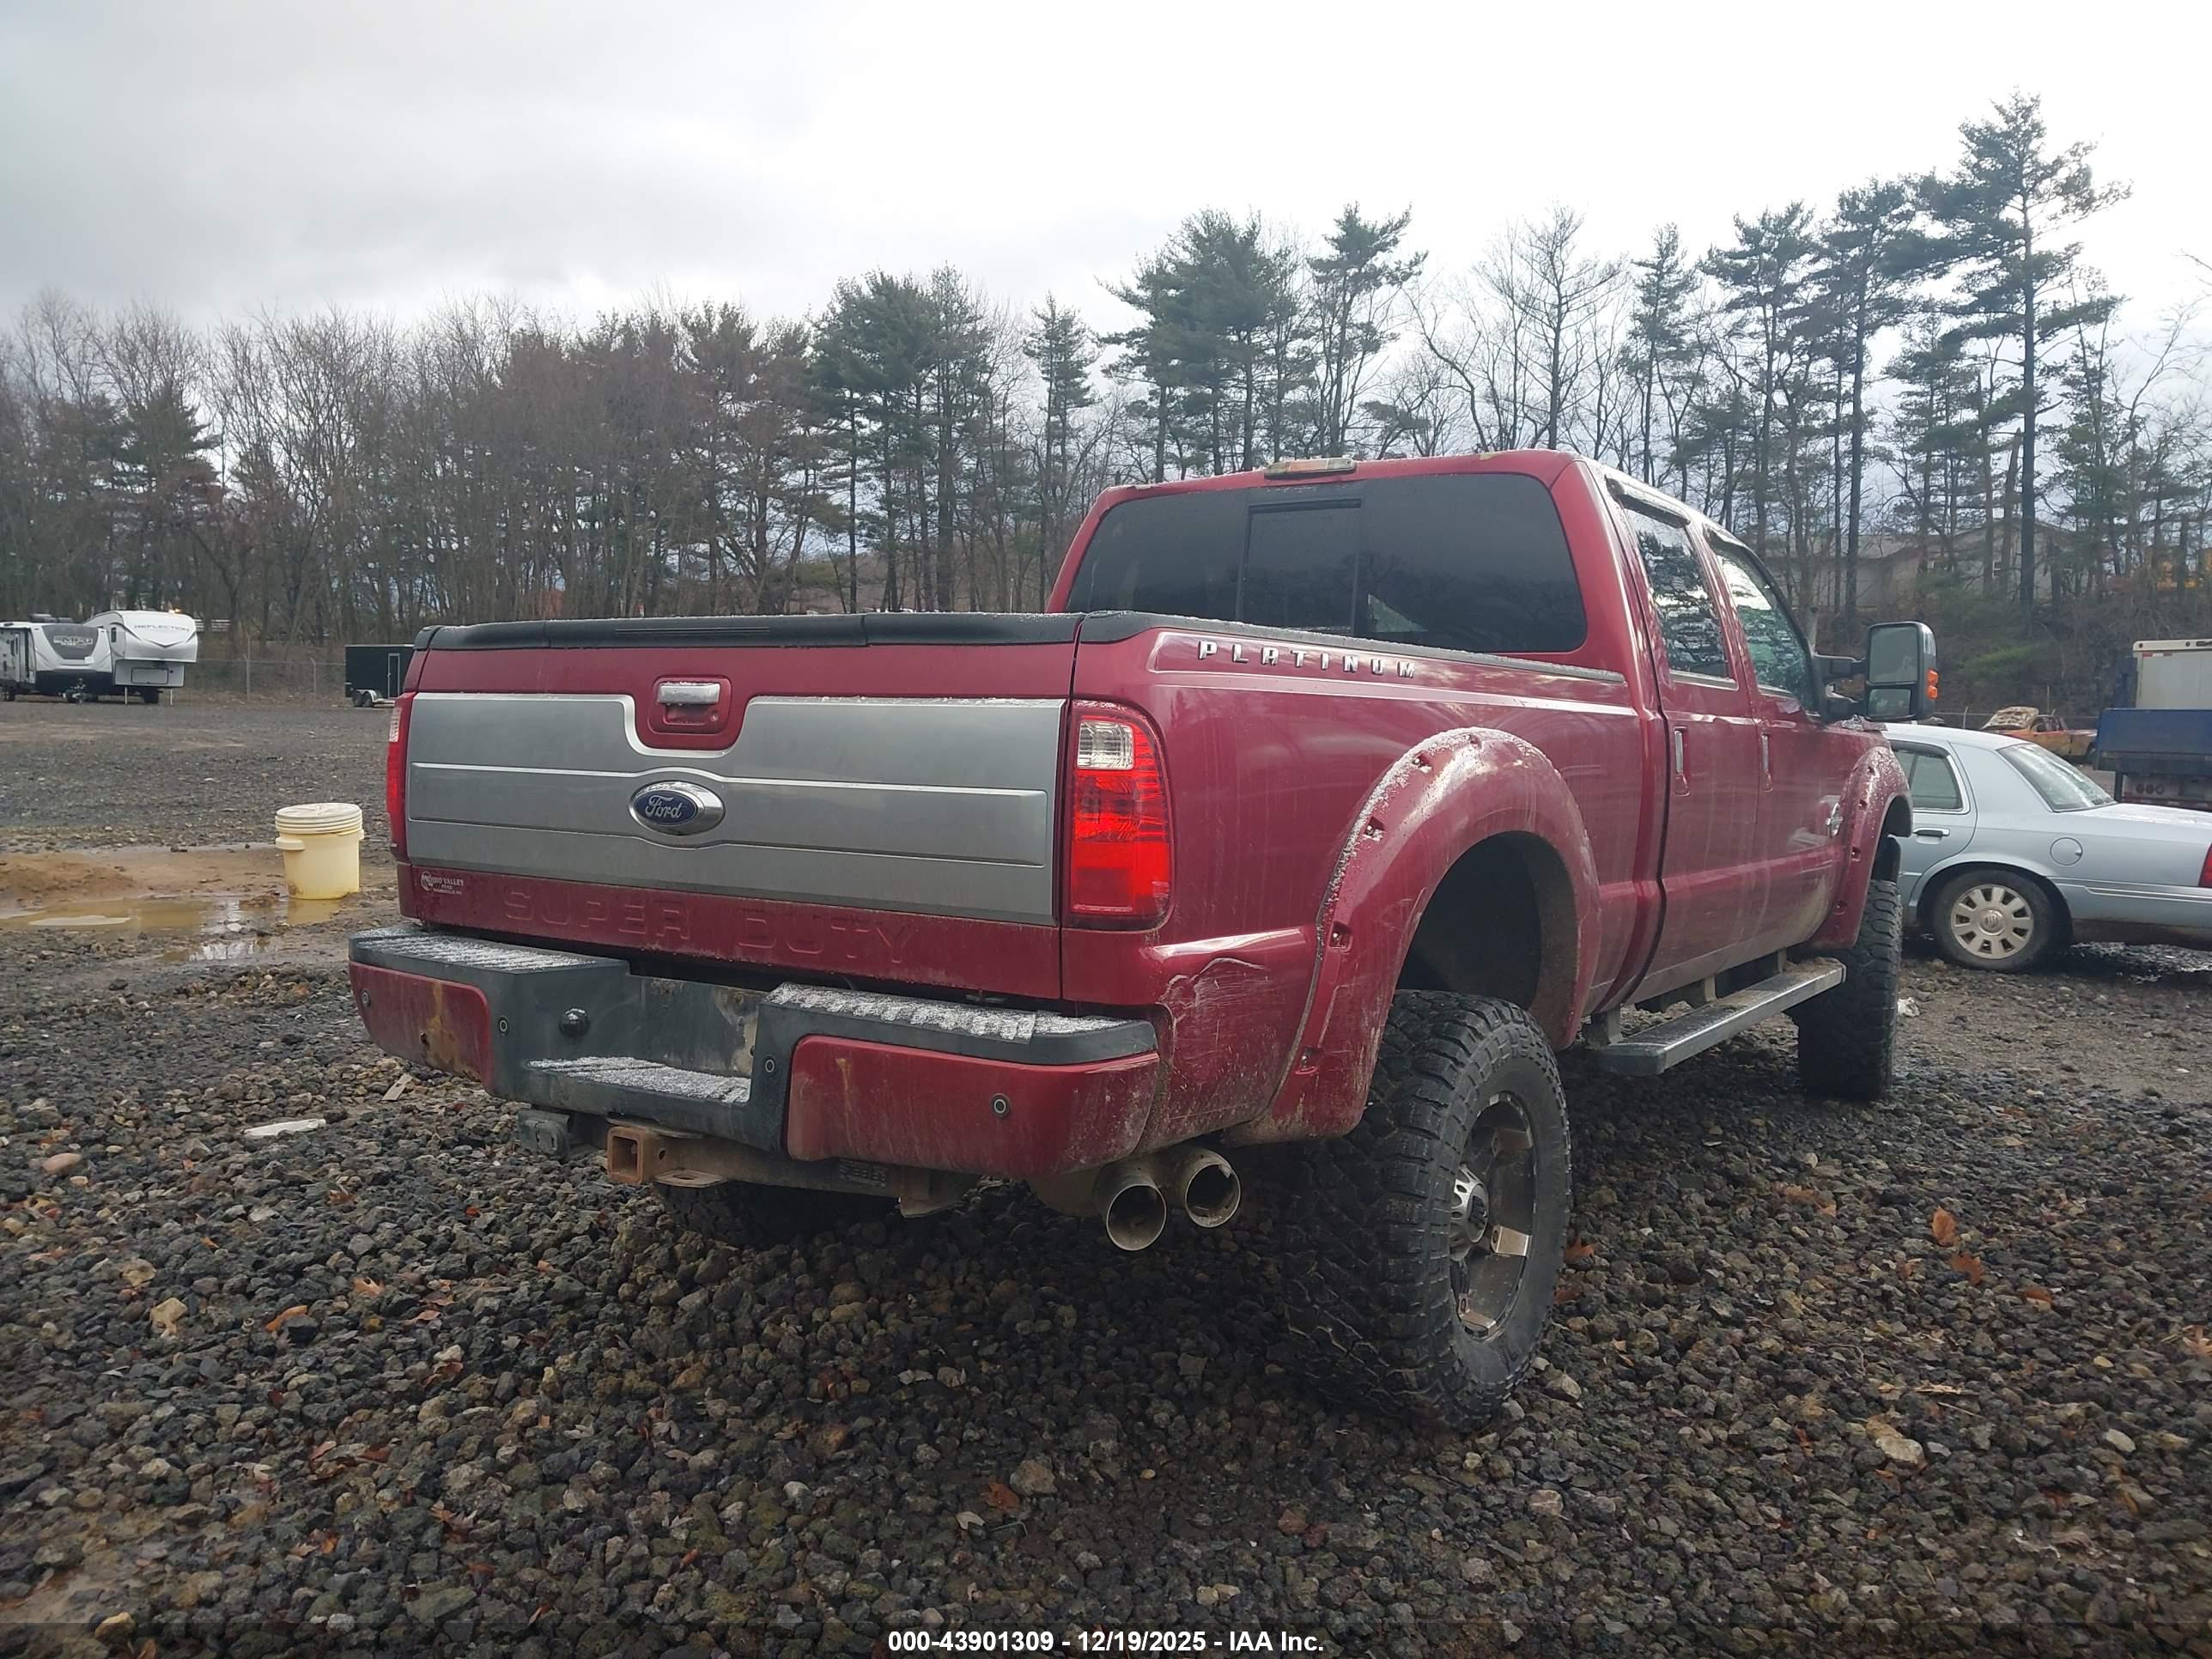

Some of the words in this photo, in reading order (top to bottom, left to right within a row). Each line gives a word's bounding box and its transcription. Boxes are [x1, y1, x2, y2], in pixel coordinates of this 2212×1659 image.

[1198, 641, 1416, 678] PLATINUM
[645, 794, 684, 819] Ford
[502, 890, 690, 940] SUPER
[738, 907, 914, 963] DUTY
